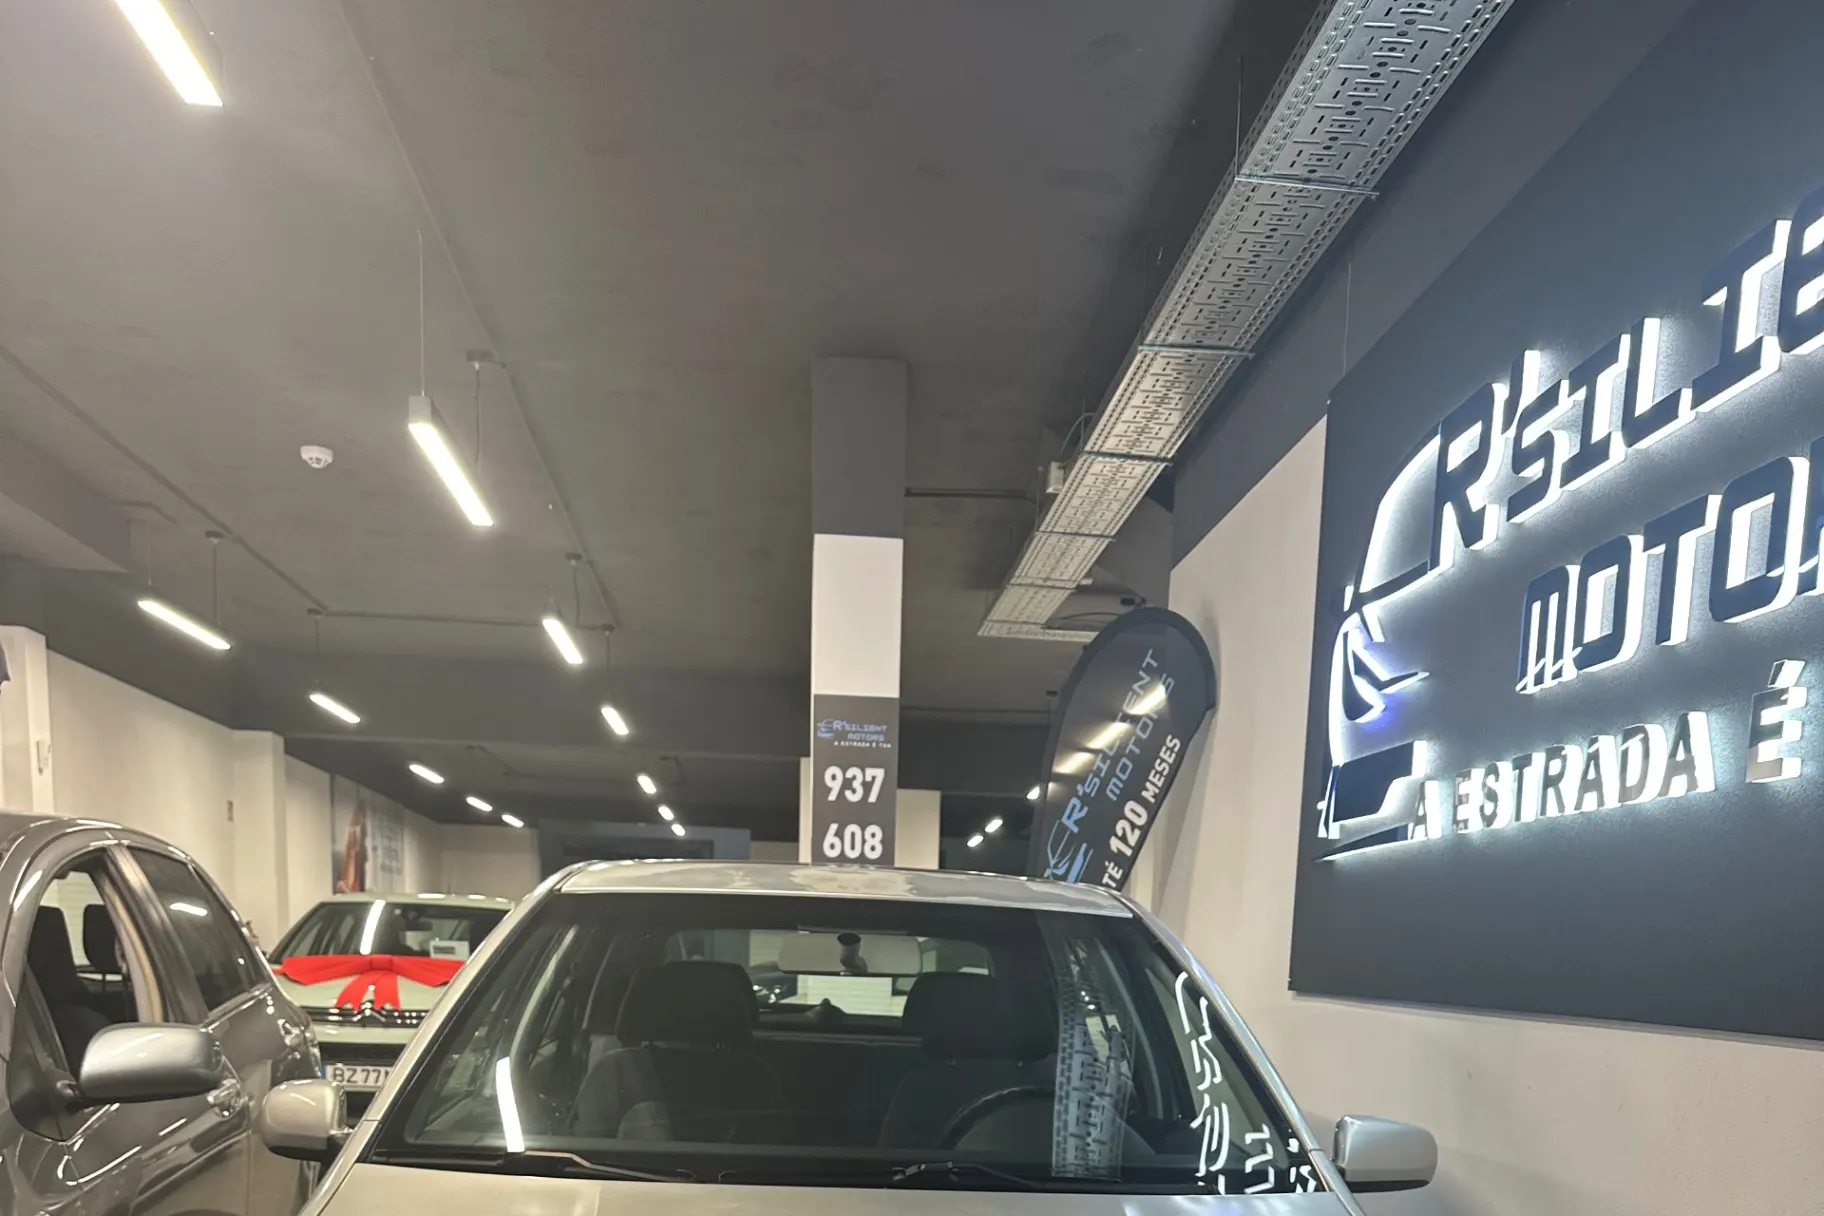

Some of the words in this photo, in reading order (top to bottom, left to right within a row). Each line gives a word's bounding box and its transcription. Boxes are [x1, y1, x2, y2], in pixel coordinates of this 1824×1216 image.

[824, 765, 885, 803] 937
[1410, 780, 1442, 841] A
[1452, 710, 1717, 834] ESTRADA
[1745, 658, 1808, 784] É
[1109, 800, 1148, 857] 120
[1141, 734, 1181, 804] MESES
[822, 823, 884, 860] 608
